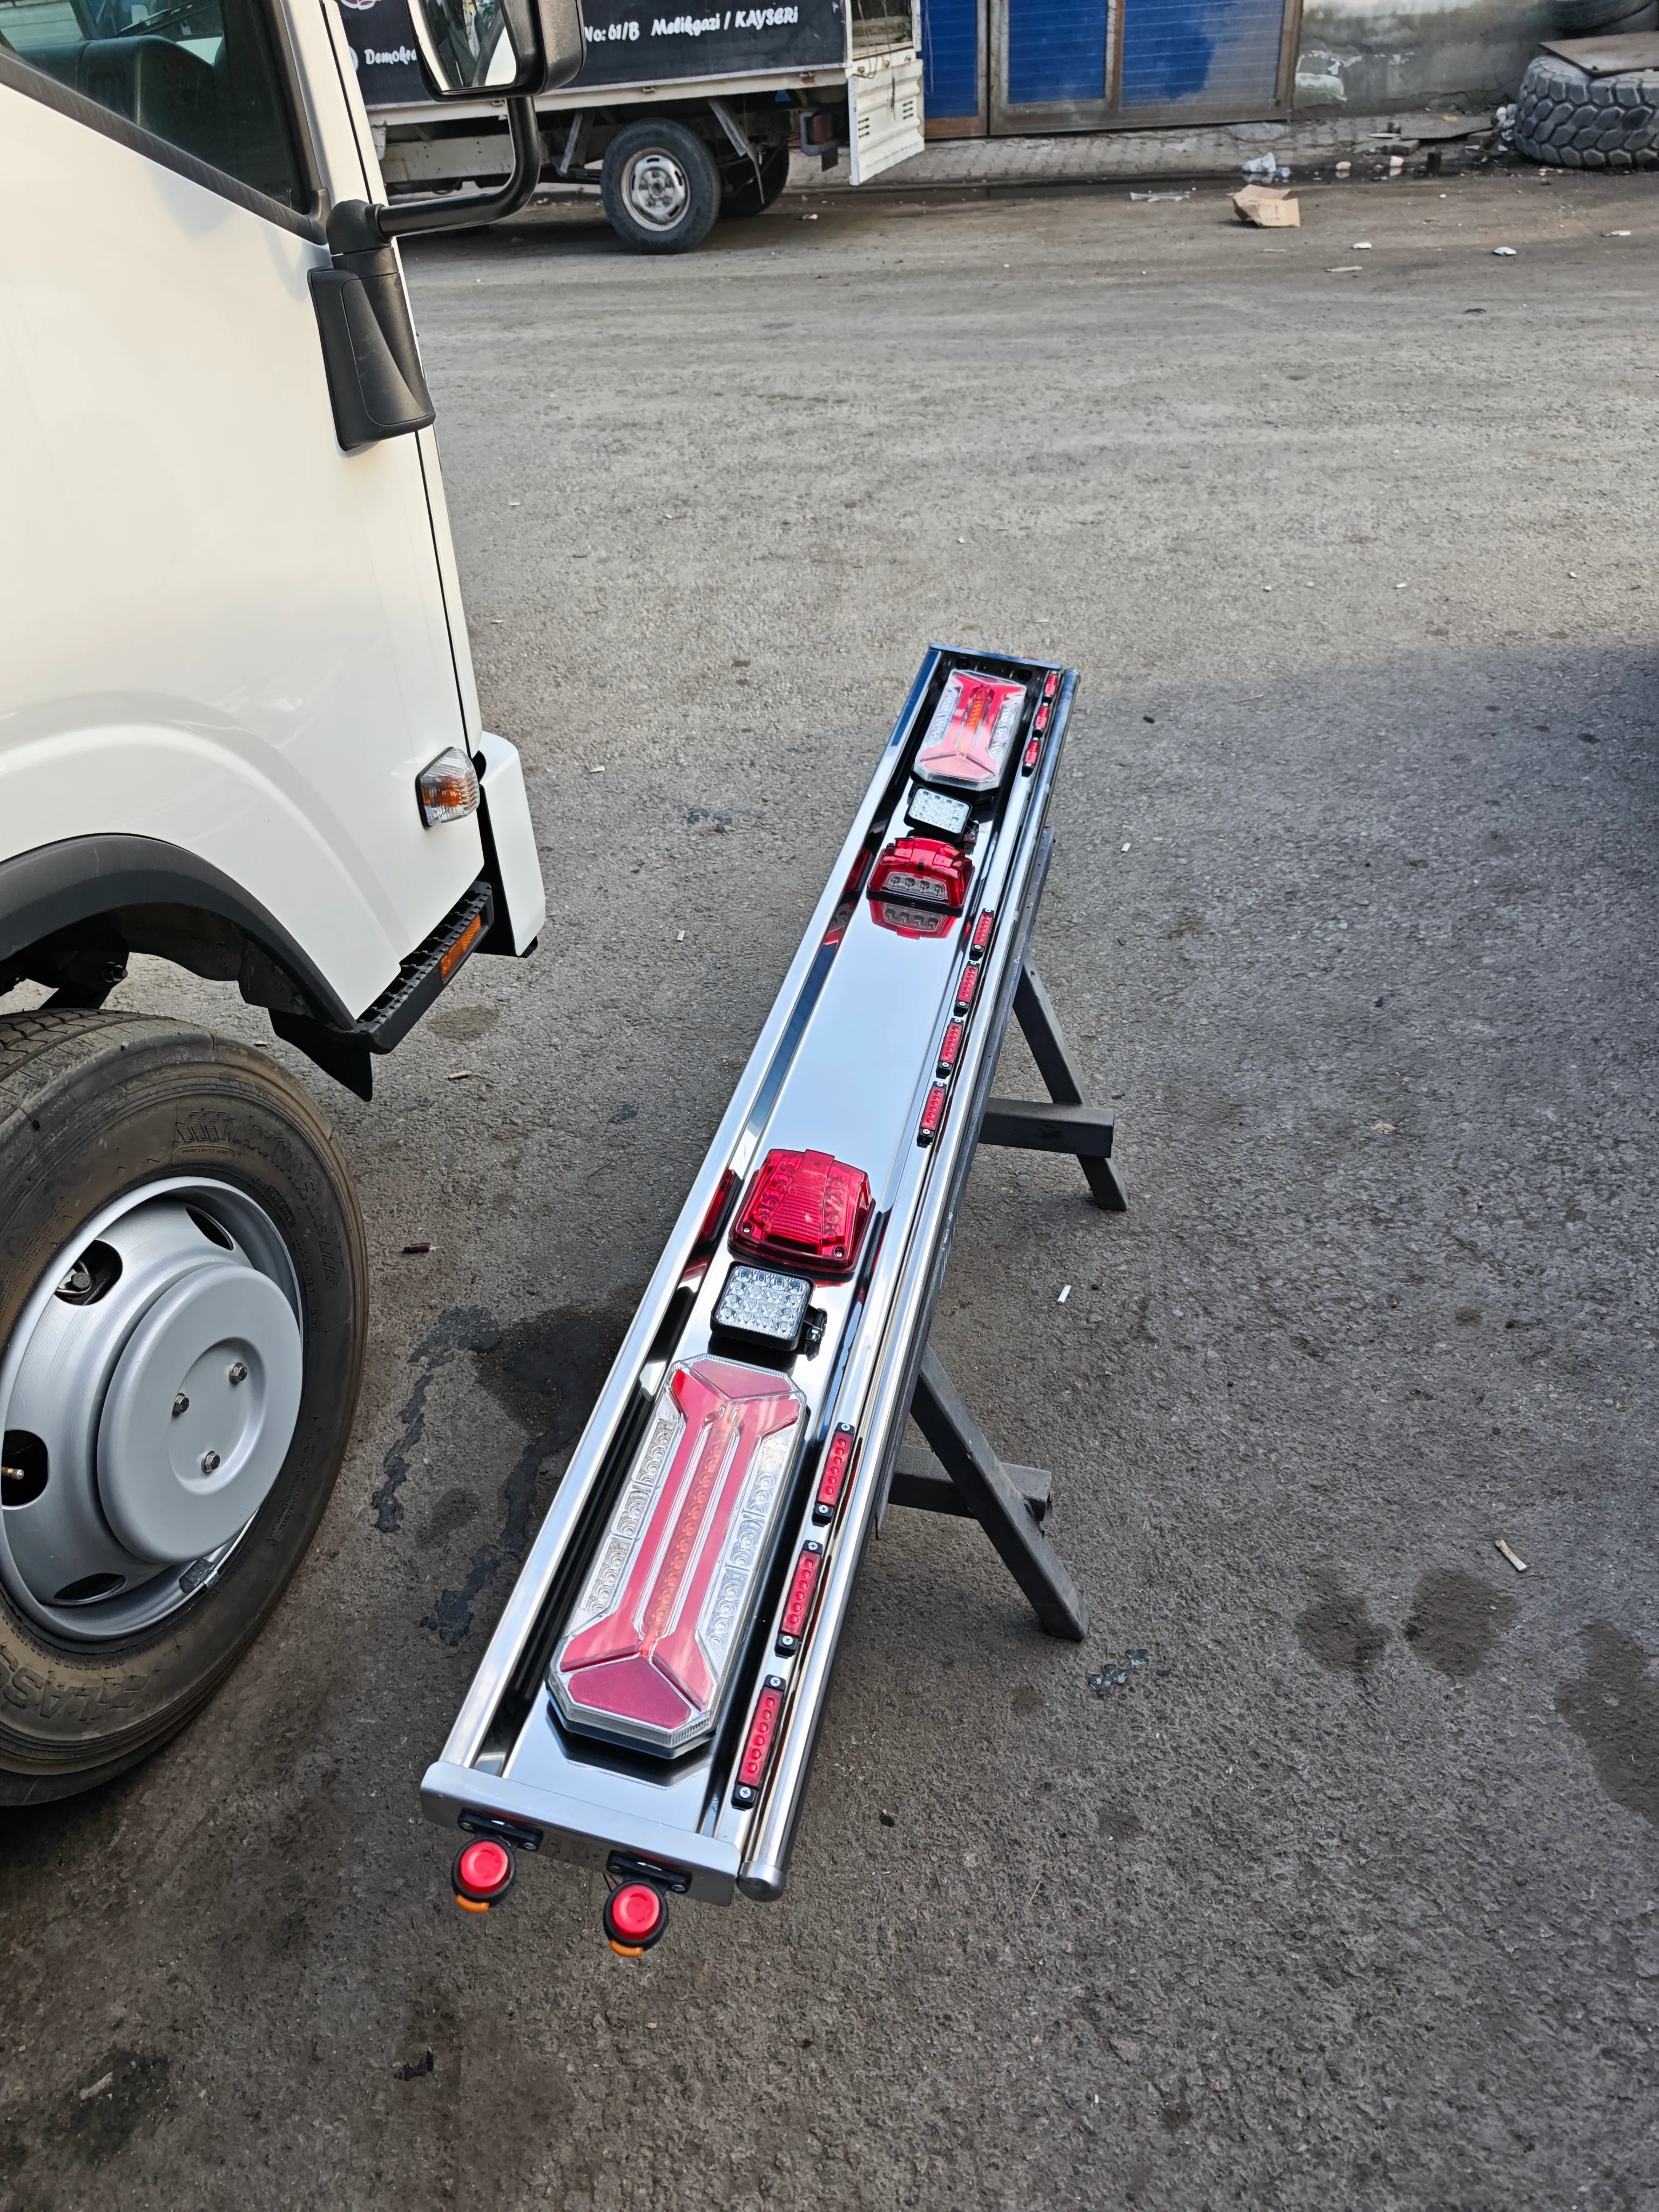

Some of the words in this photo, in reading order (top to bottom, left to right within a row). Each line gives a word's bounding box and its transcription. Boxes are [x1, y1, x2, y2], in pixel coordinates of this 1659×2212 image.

[584, 26, 606, 42] No:
[608, 22, 640, 41] 61/B
[651, 13, 720, 36] Melikgazi
[724, 11, 731, 30] /
